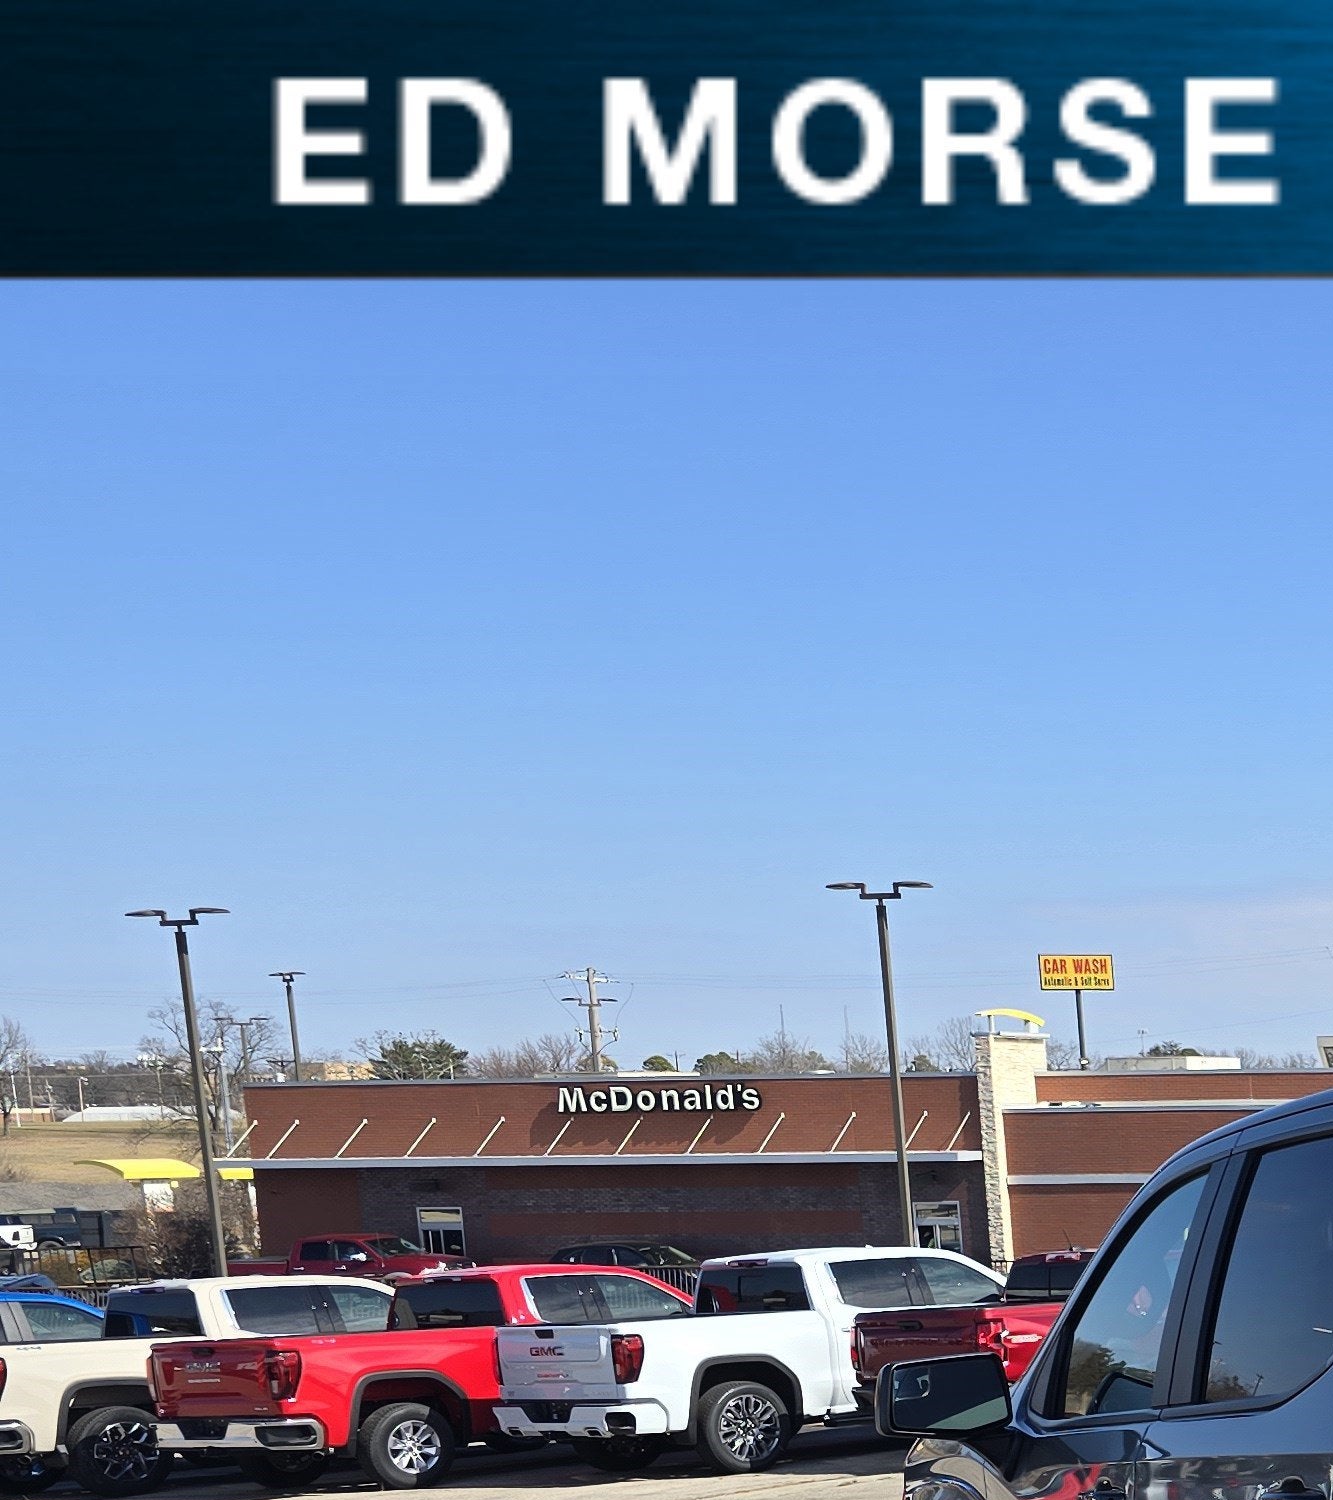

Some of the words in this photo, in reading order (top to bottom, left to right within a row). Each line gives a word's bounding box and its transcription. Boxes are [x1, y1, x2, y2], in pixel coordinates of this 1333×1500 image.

[1044, 959, 1067, 974] CAR
[1072, 958, 1108, 974] WASH
[558, 1084, 760, 1112] McDonald's
[530, 1347, 565, 1357] GMC
